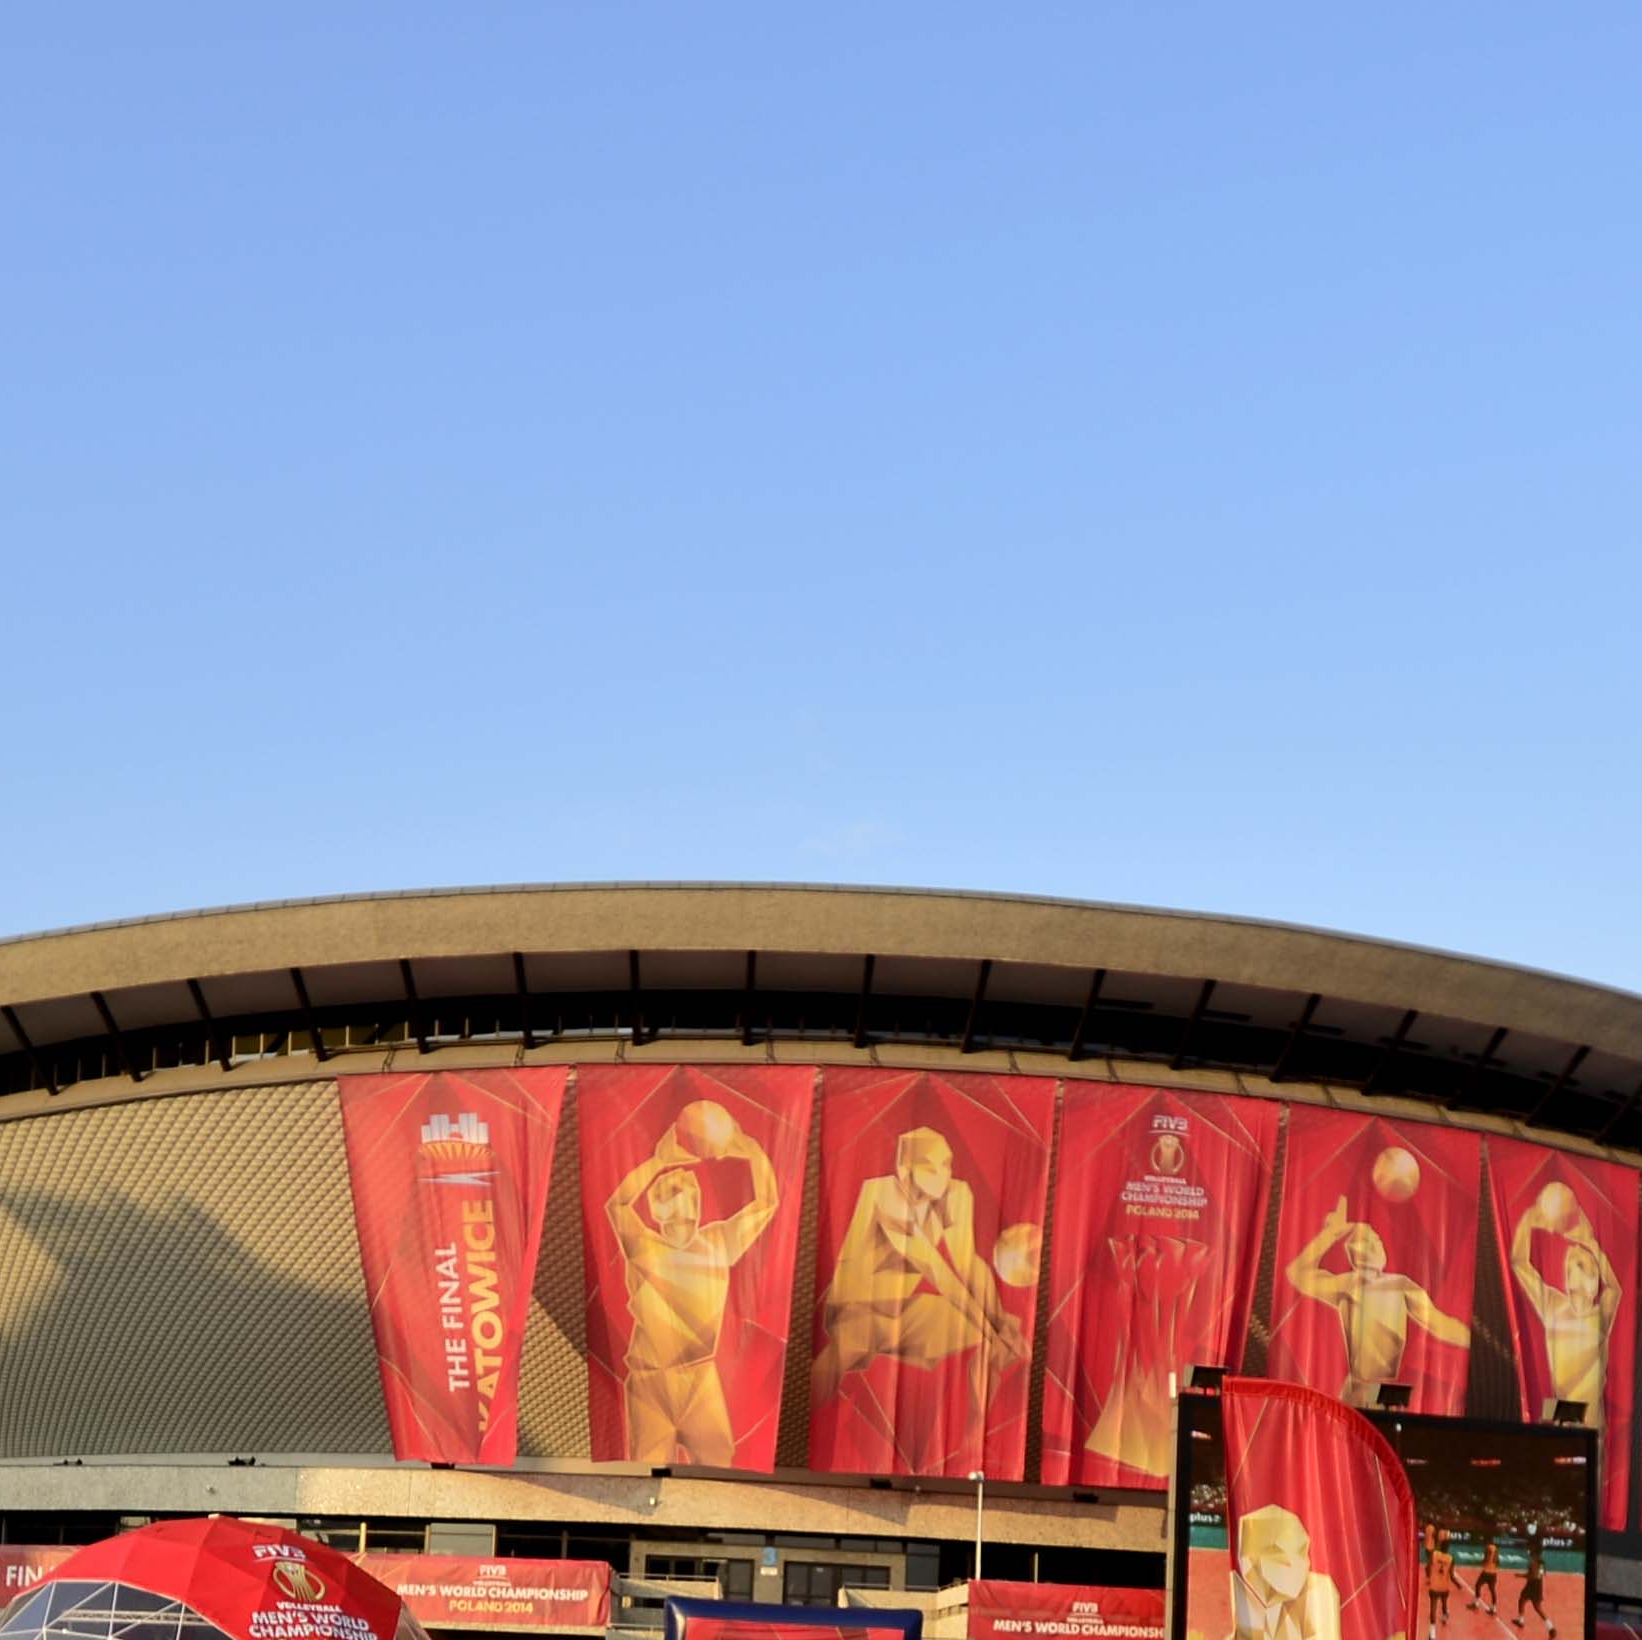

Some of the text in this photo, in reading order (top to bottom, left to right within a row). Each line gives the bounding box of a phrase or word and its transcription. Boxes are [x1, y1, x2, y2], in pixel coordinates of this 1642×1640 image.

[1153, 1115, 1188, 1130] FIVB
[1126, 1204, 1173, 1218] POLAND
[435, 1242, 470, 1392] THE FINAL
[253, 1544, 305, 1559] FIVB
[7, 1565, 47, 1587] FIN
[479, 1565, 506, 1576] FIVB
[396, 1584, 588, 1601] MEN'S WORLD CHAMPIONSHIP
[449, 1600, 533, 1613] POLAND 2014
[1072, 1602, 1098, 1613] FIVB
[252, 1612, 369, 1631] MEN'S WORLD
[993, 1619, 1164, 1639] MEN'S WORLD CHAMPIONSH
